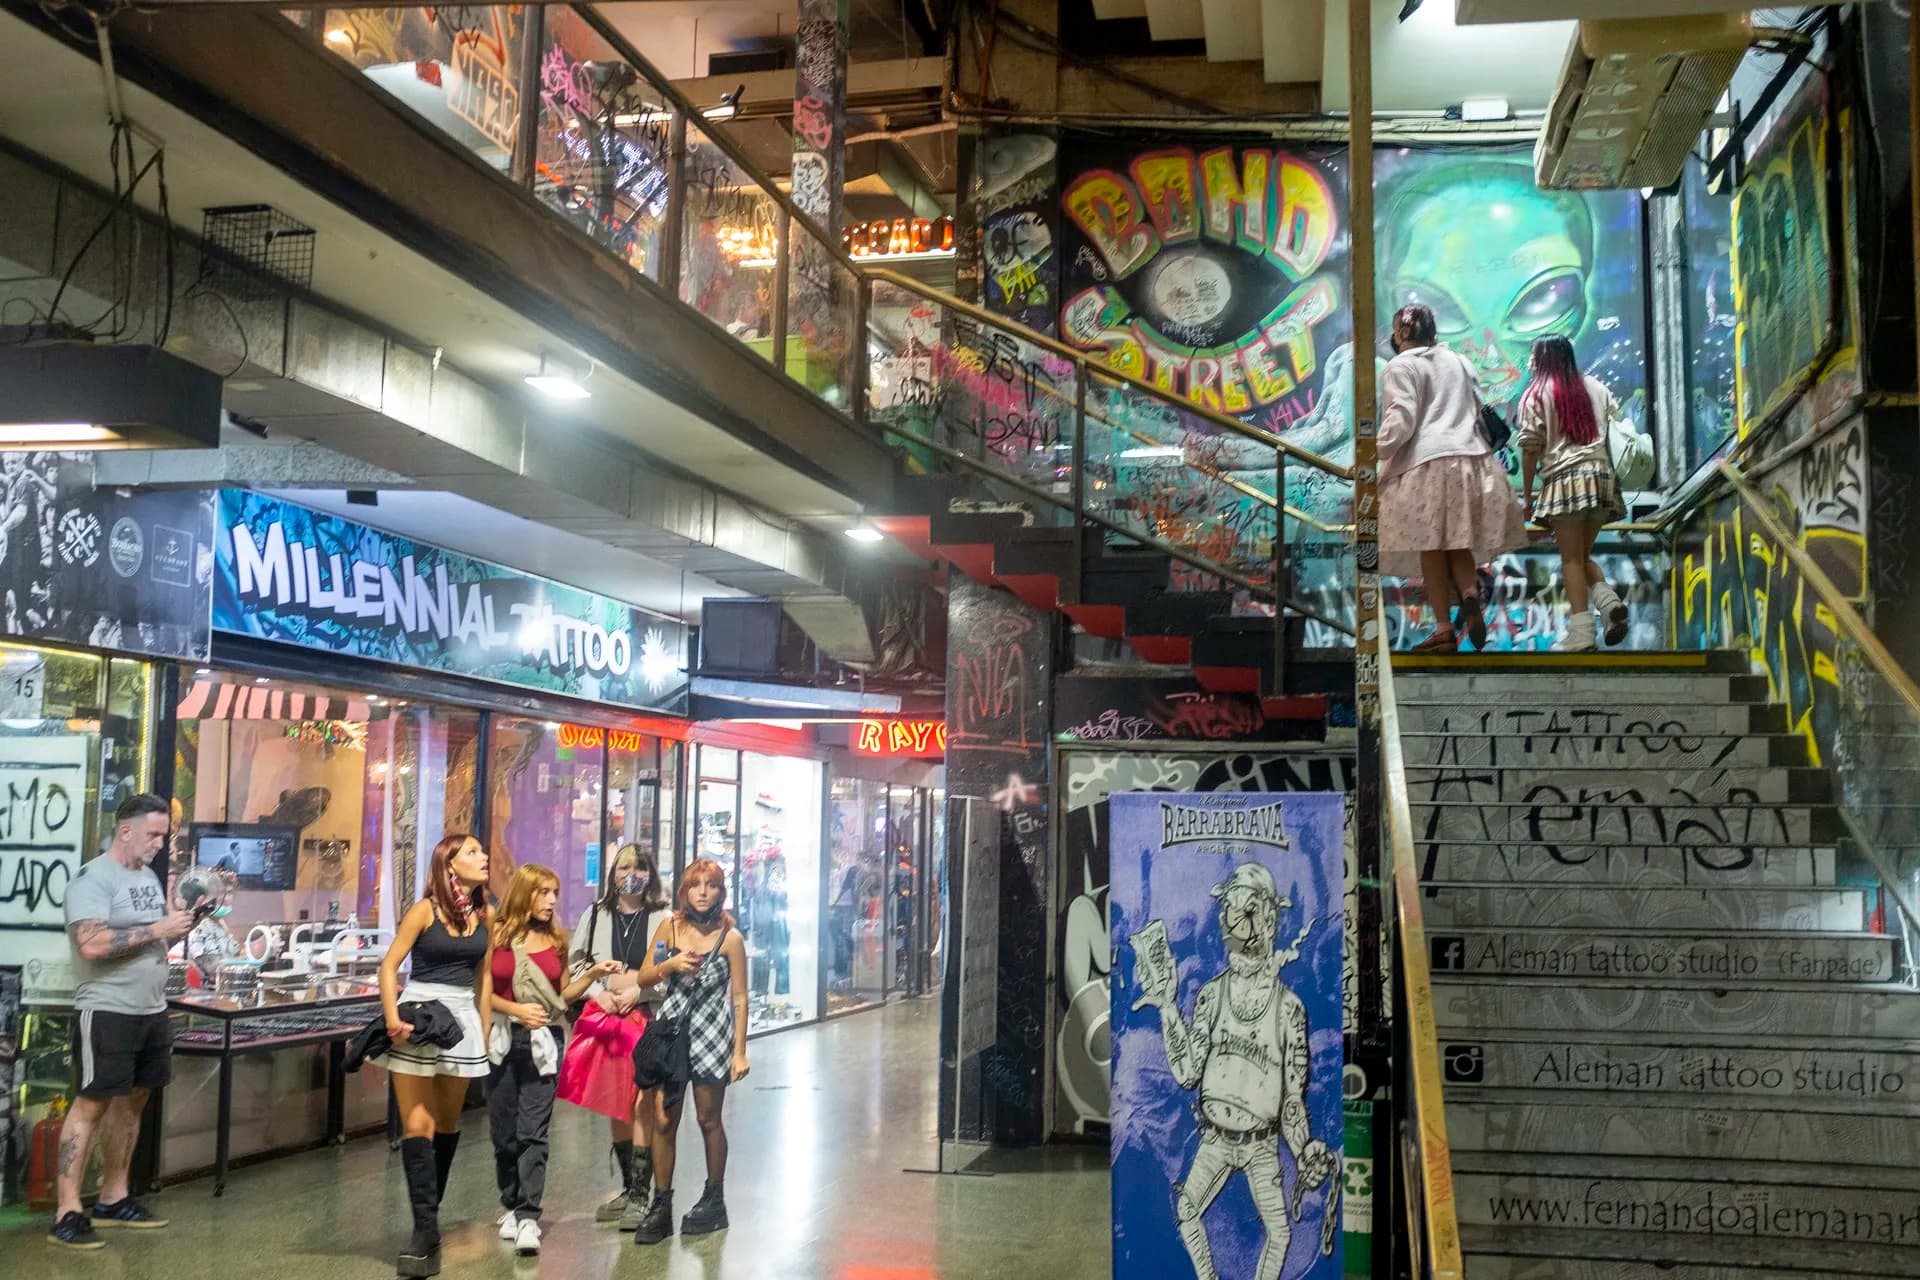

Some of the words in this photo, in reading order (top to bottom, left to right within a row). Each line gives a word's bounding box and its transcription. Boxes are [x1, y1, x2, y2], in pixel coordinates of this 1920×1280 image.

[1061, 146, 1337, 283] BOND
[1060, 274, 1338, 414] STREET
[232, 519, 509, 652] MILLENNIAL
[509, 601, 633, 676] TATTOO
[15, 677, 33, 698] 15
[0, 777, 71, 841] MO
[1160, 800, 1290, 852] BARRABRAVA
[1477, 939, 1578, 974] Aleman
[1587, 943, 1669, 974] tattoo
[1677, 944, 1758, 976] studio
[1532, 1045, 1665, 1087] Aleman
[1680, 1056, 1784, 1092] tattoo
[1794, 1058, 1905, 1096] studio
